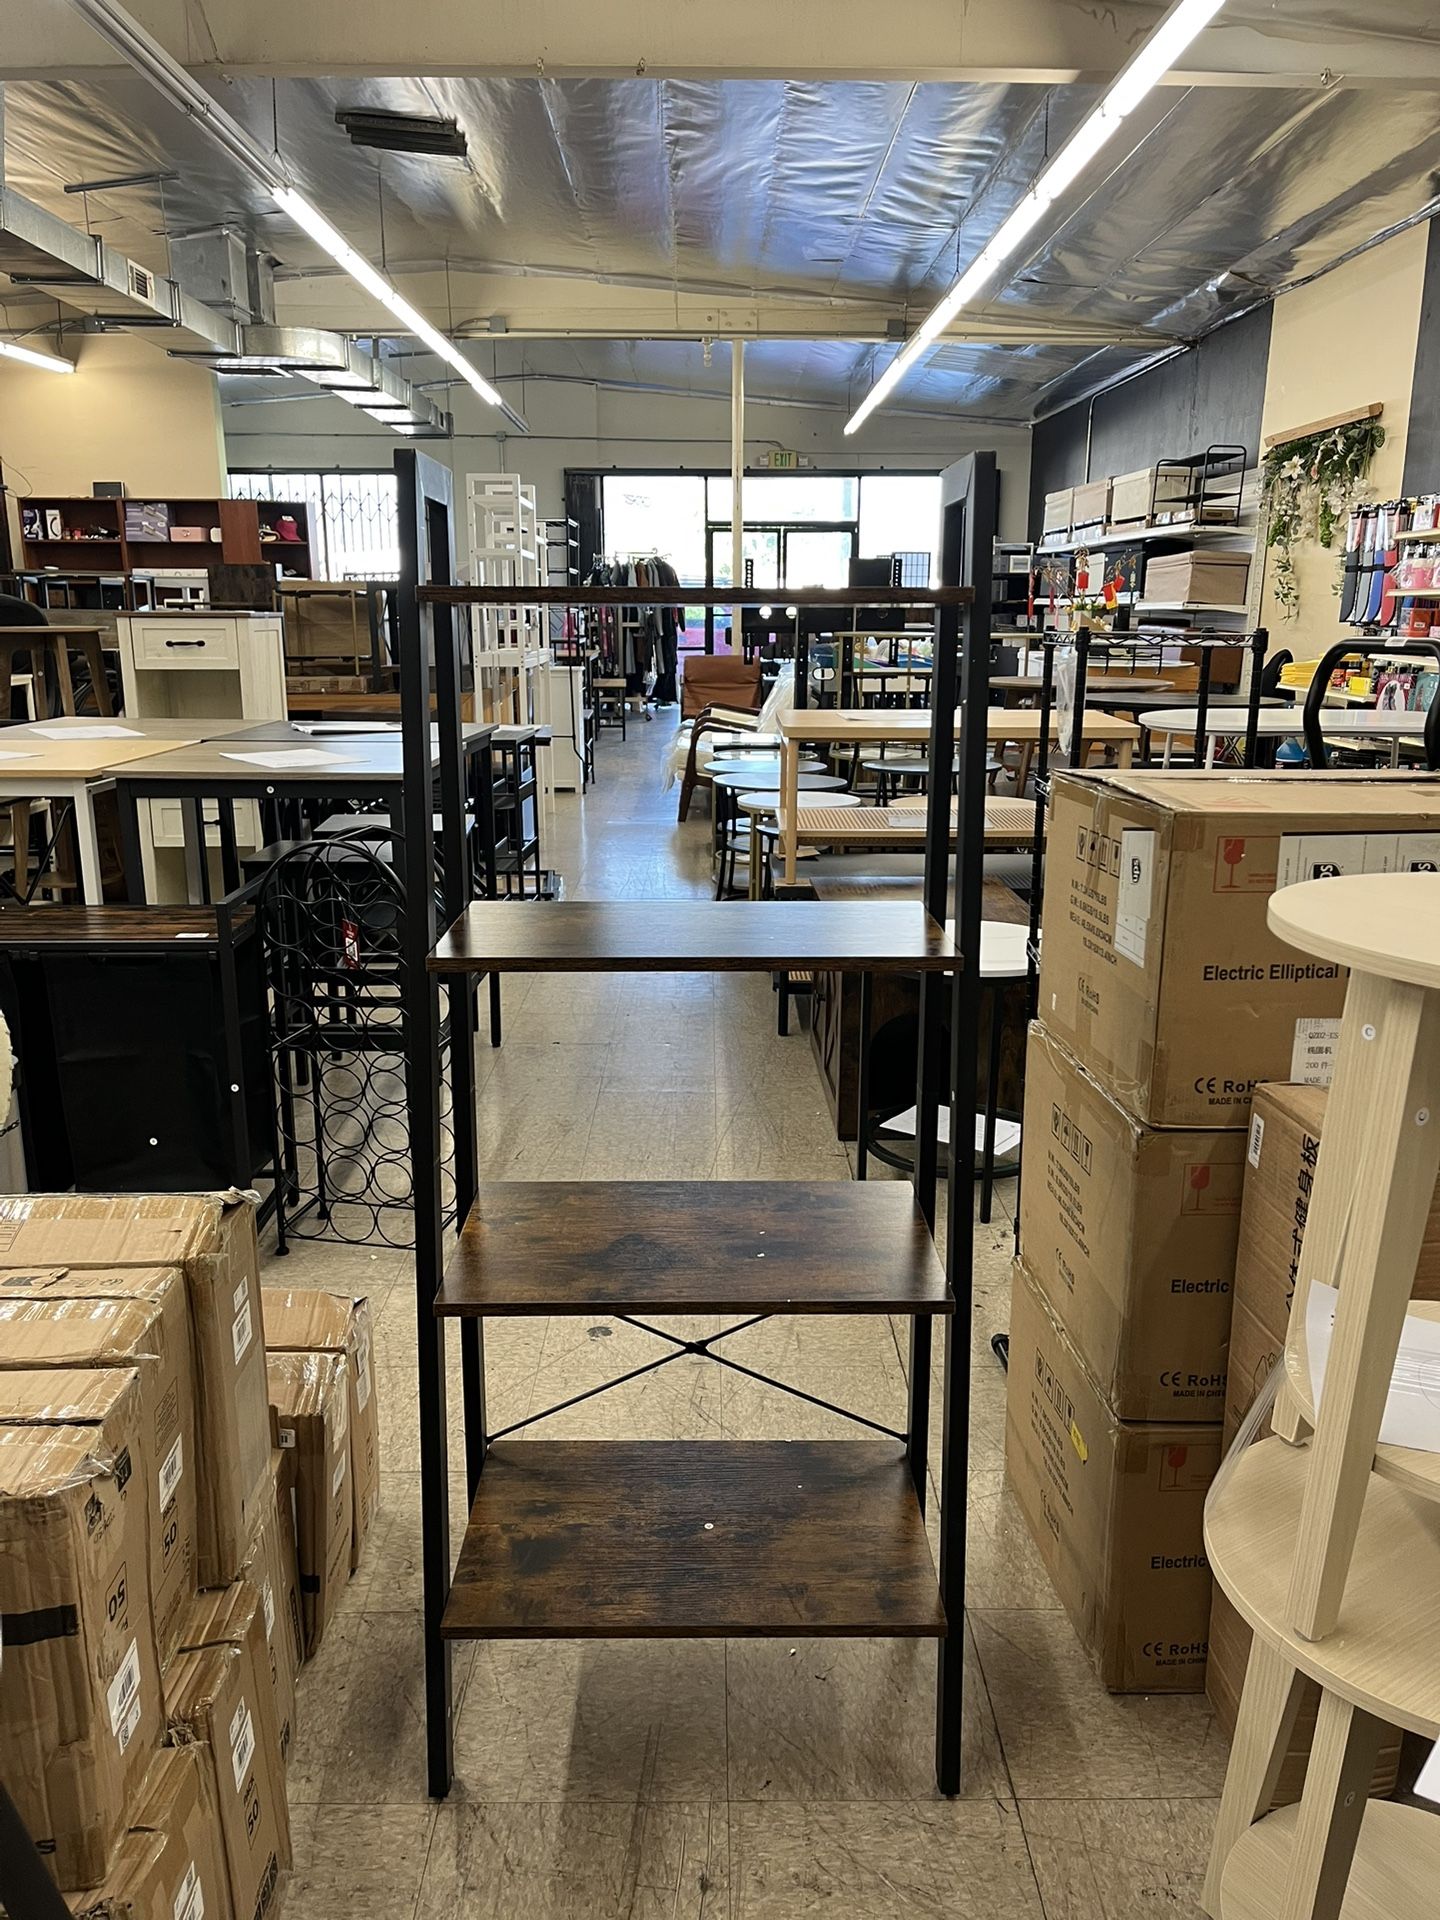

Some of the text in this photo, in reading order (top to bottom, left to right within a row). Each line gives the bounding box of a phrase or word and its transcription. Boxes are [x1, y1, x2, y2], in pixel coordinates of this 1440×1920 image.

[774, 452, 793, 467] EXIT
[1203, 964, 1339, 983] Electric Elliptical
[1223, 1079, 1270, 1093] RoH
[1171, 1279, 1230, 1293] Electric
[164, 1522, 176, 1557] 50
[1151, 1555, 1206, 1569] Electric
[109, 1579, 125, 1622] 50
[248, 1798, 259, 1836] 50
